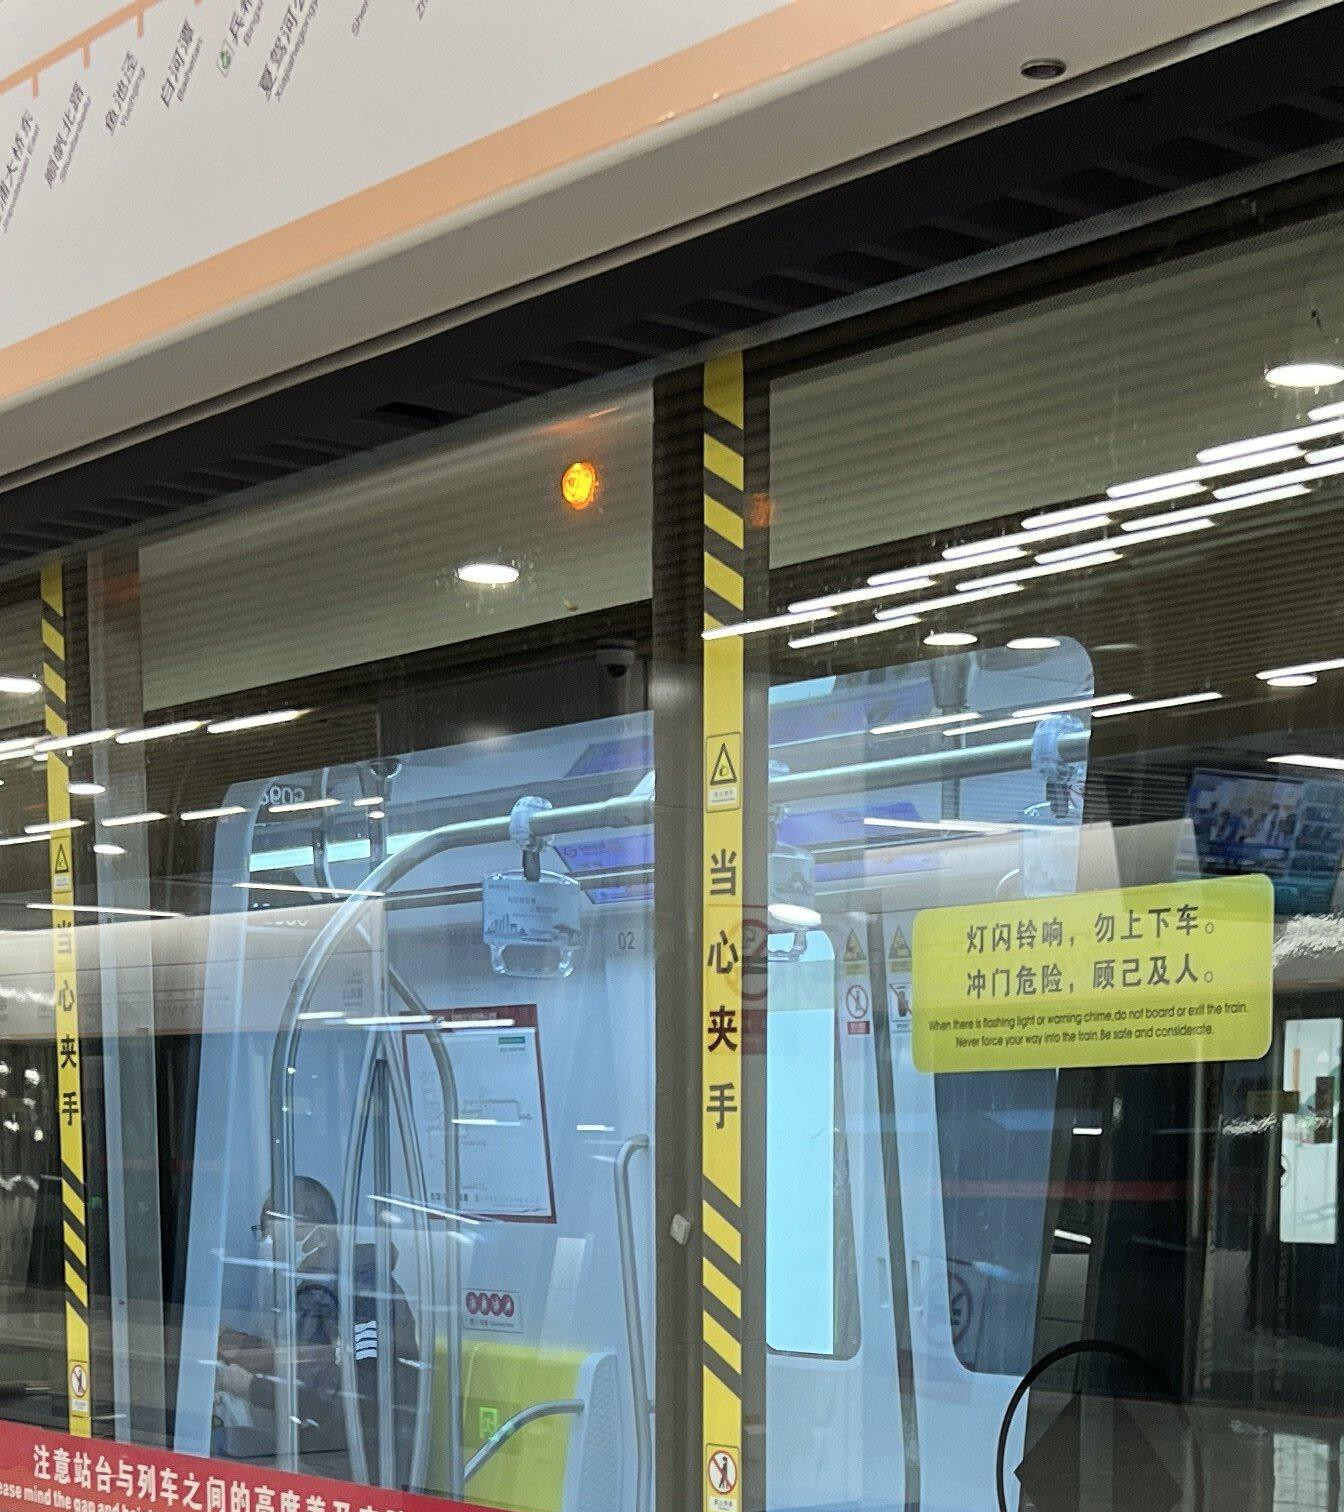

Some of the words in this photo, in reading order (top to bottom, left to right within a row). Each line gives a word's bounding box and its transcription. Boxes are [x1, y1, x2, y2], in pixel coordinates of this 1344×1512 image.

[618, 931, 635, 951] 02
[966, 904, 1214, 954] 灯闪铃响，勿上下车。
[966, 952, 1214, 999] 冲门危险，顾己及人。
[707, 849, 739, 1131] 当心夹手
[929, 1020, 951, 1031] When
[953, 1019, 974, 1030] there
[1017, 1016, 1036, 1029] light
[1037, 1015, 1046, 1026] or
[1048, 1013, 1082, 1025] warning
[1128, 1009, 1144, 1019] not
[1146, 1006, 1174, 1018] board
[1176, 1008, 1186, 1017] or
[1207, 1003, 1222, 1014] the
[956, 1037, 980, 1048] Never
[982, 1036, 1003, 1046] force
[1005, 1036, 1024, 1046] your
[1026, 1036, 1043, 1045] way
[1044, 1032, 1060, 1043] into
[1062, 1032, 1076, 1042] the
[1113, 1028, 1132, 1039] safe
[1134, 1027, 1153, 1038] and
[24, 1484, 50, 1506] mind
[54, 1490, 71, 1510] the
